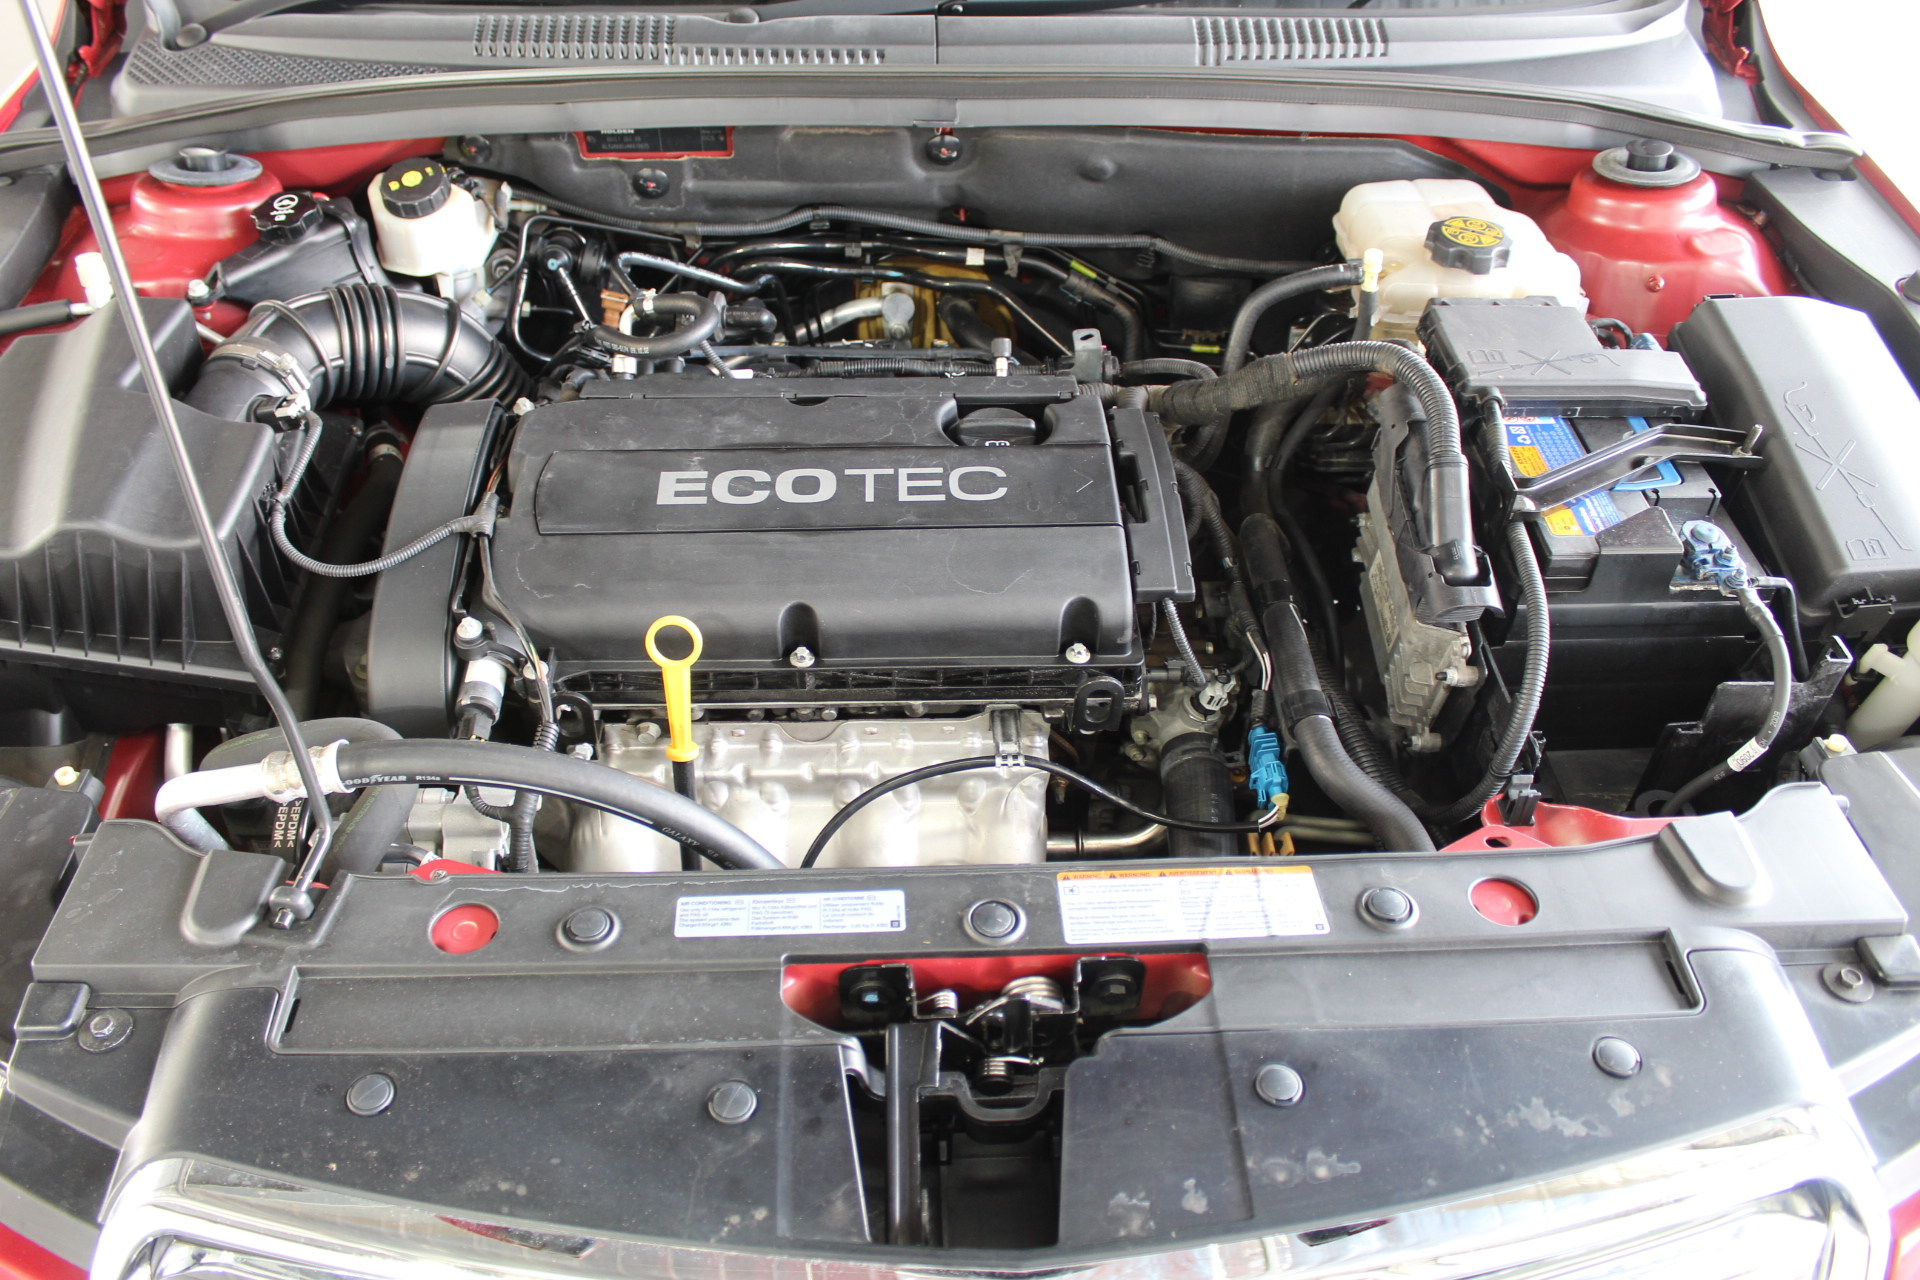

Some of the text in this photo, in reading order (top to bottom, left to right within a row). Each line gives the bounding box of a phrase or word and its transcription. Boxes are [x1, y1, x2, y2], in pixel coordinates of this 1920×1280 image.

[656, 466, 1009, 505] ECOTEC
[1770, 710, 1780, 728] 2009
[286, 800, 302, 848] >EPDM<
[662, 827, 700, 847] GALAXY
